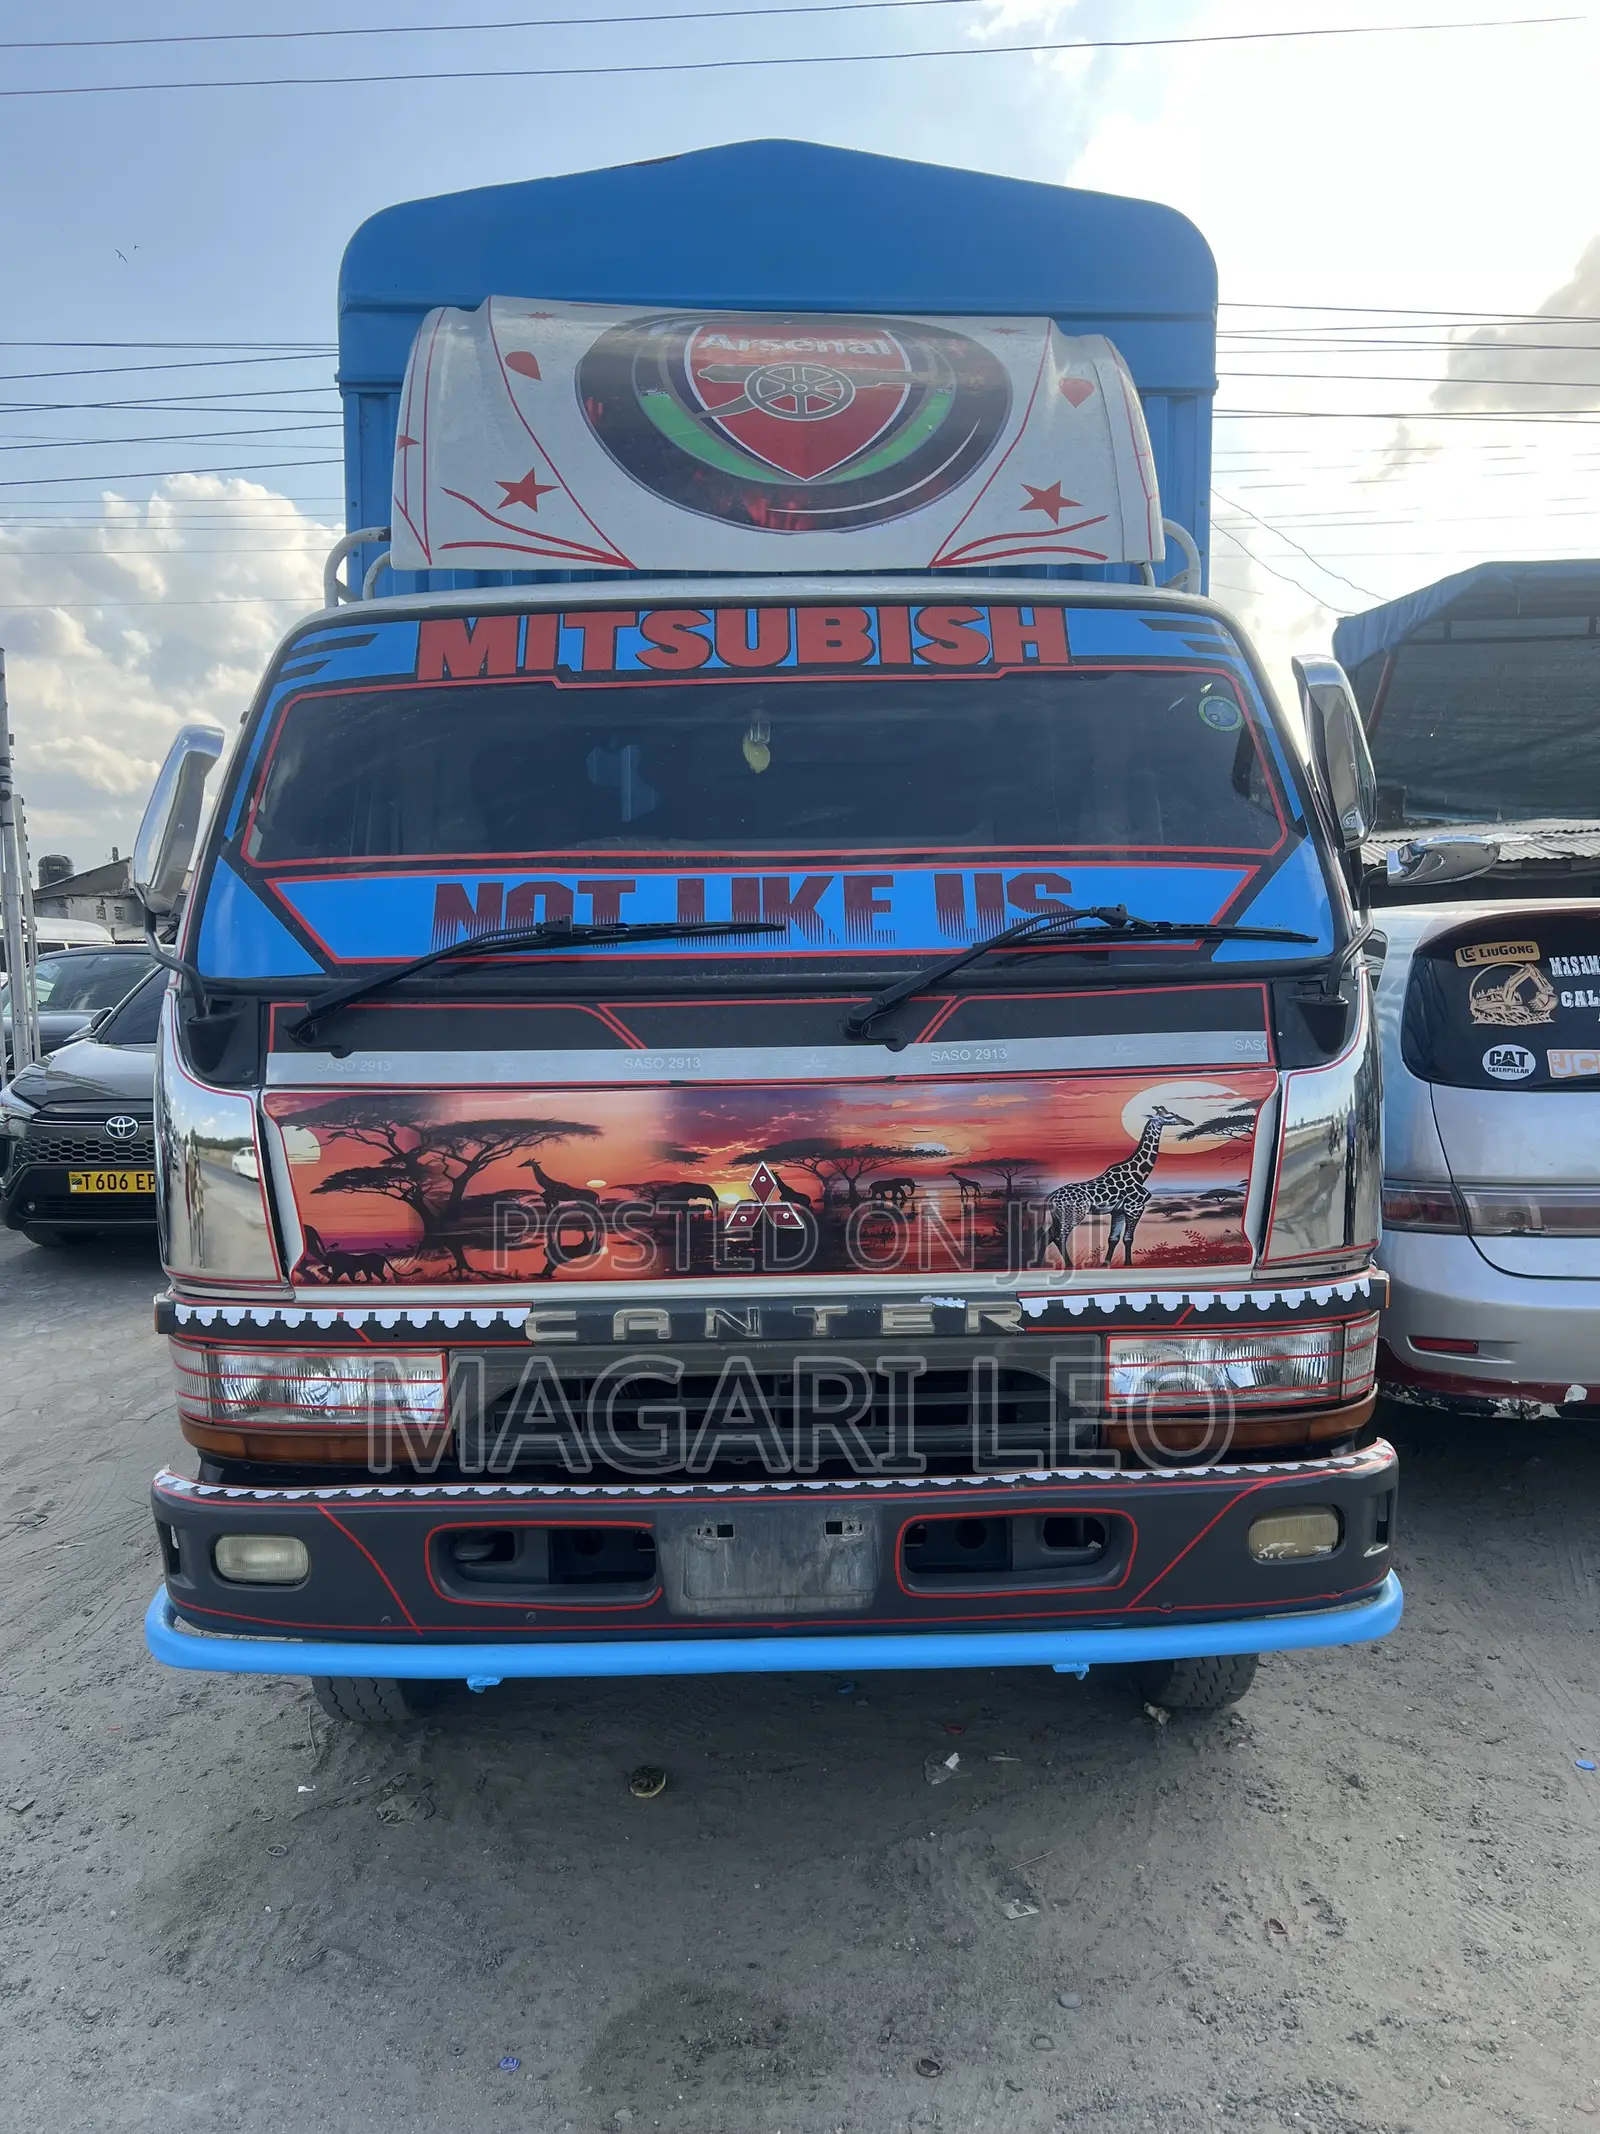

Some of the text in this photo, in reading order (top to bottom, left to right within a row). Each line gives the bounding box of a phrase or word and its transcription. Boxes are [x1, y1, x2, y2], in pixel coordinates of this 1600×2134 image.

[697, 333, 894, 356] Arsenal
[416, 606, 1072, 681] MITSUBISH
[431, 872, 1078, 952] NOT LIKE US
[1549, 956, 1600, 977] MASAM
[1561, 990, 1600, 1008] CAL
[624, 1057, 701, 1069] SASO 2913
[931, 1048, 1007, 1062] SASO 2913
[1490, 1051, 1529, 1068] CAT
[1551, 1053, 1600, 1075] JC
[359, 1060, 392, 1072] 2913
[82, 1174, 156, 1190] T 606 EP
[524, 1301, 1024, 1344] CANTER
